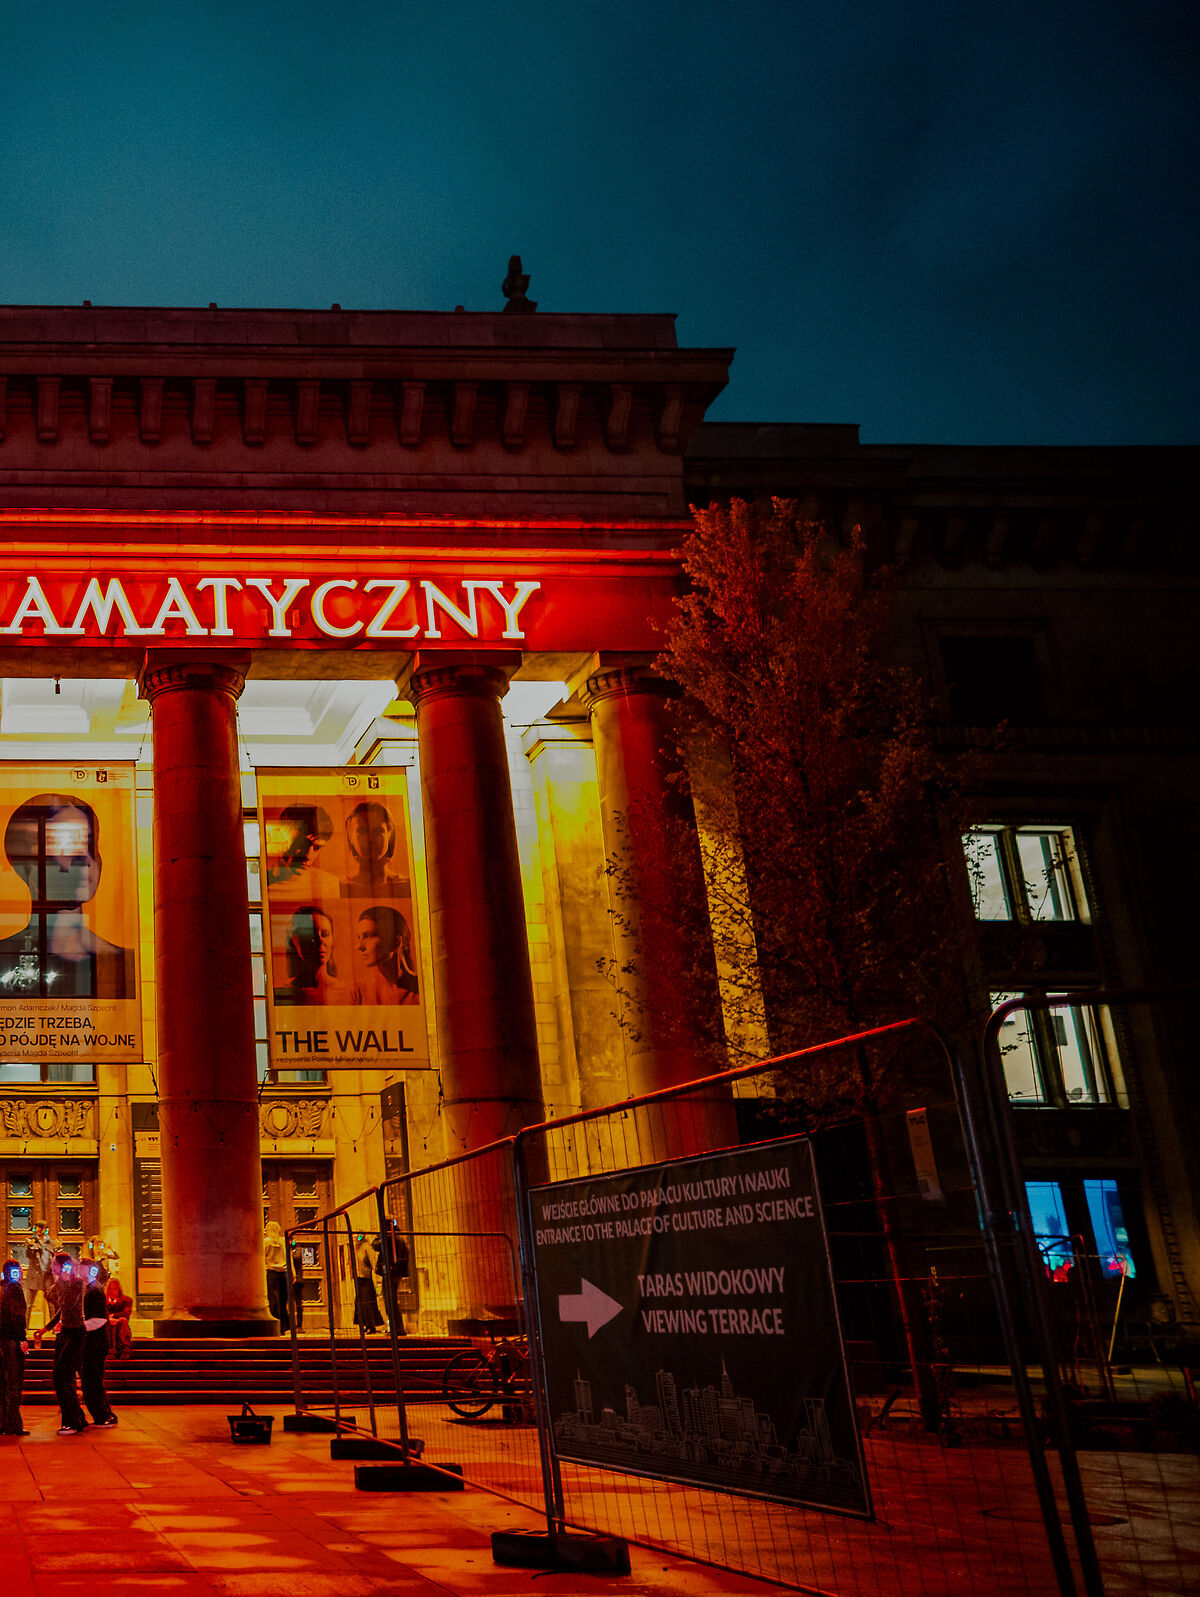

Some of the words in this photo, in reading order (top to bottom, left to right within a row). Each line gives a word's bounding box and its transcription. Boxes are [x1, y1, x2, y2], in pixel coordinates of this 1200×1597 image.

[61, 1004, 86, 1013] Magda
[38, 1017, 96, 1031] TRZEBA,
[9, 1031, 57, 1048] PÓJDĘ
[59, 1034, 81, 1046] NA
[83, 1034, 136, 1049] WOJNĘ
[275, 1031, 330, 1053] THE
[335, 1030, 415, 1052] WALL
[22, 1049, 48, 1058] Magda
[48, 1049, 80, 1058] Szpecht
[542, 1199, 580, 1221] WEJŚCIE
[579, 1194, 621, 1217] GŁÓWNE
[621, 1191, 640, 1211] DO
[682, 1175, 737, 1203] KULTURY
[738, 1173, 745, 1194] I
[745, 1167, 791, 1193] NAUKI
[536, 1224, 581, 1247] ENTRANCE
[581, 1223, 594, 1242] TO
[592, 1221, 615, 1242] THE
[615, 1216, 652, 1240] PALACE
[653, 1214, 671, 1234] OF
[672, 1207, 725, 1232] CULTURE
[725, 1204, 754, 1226] AND
[755, 1196, 815, 1223] SCIENCE
[637, 1272, 684, 1298] TARAS
[684, 1266, 785, 1296] WIDOKOWY
[641, 1308, 708, 1334] VIEWING
[708, 1308, 785, 1335] TERRACE
